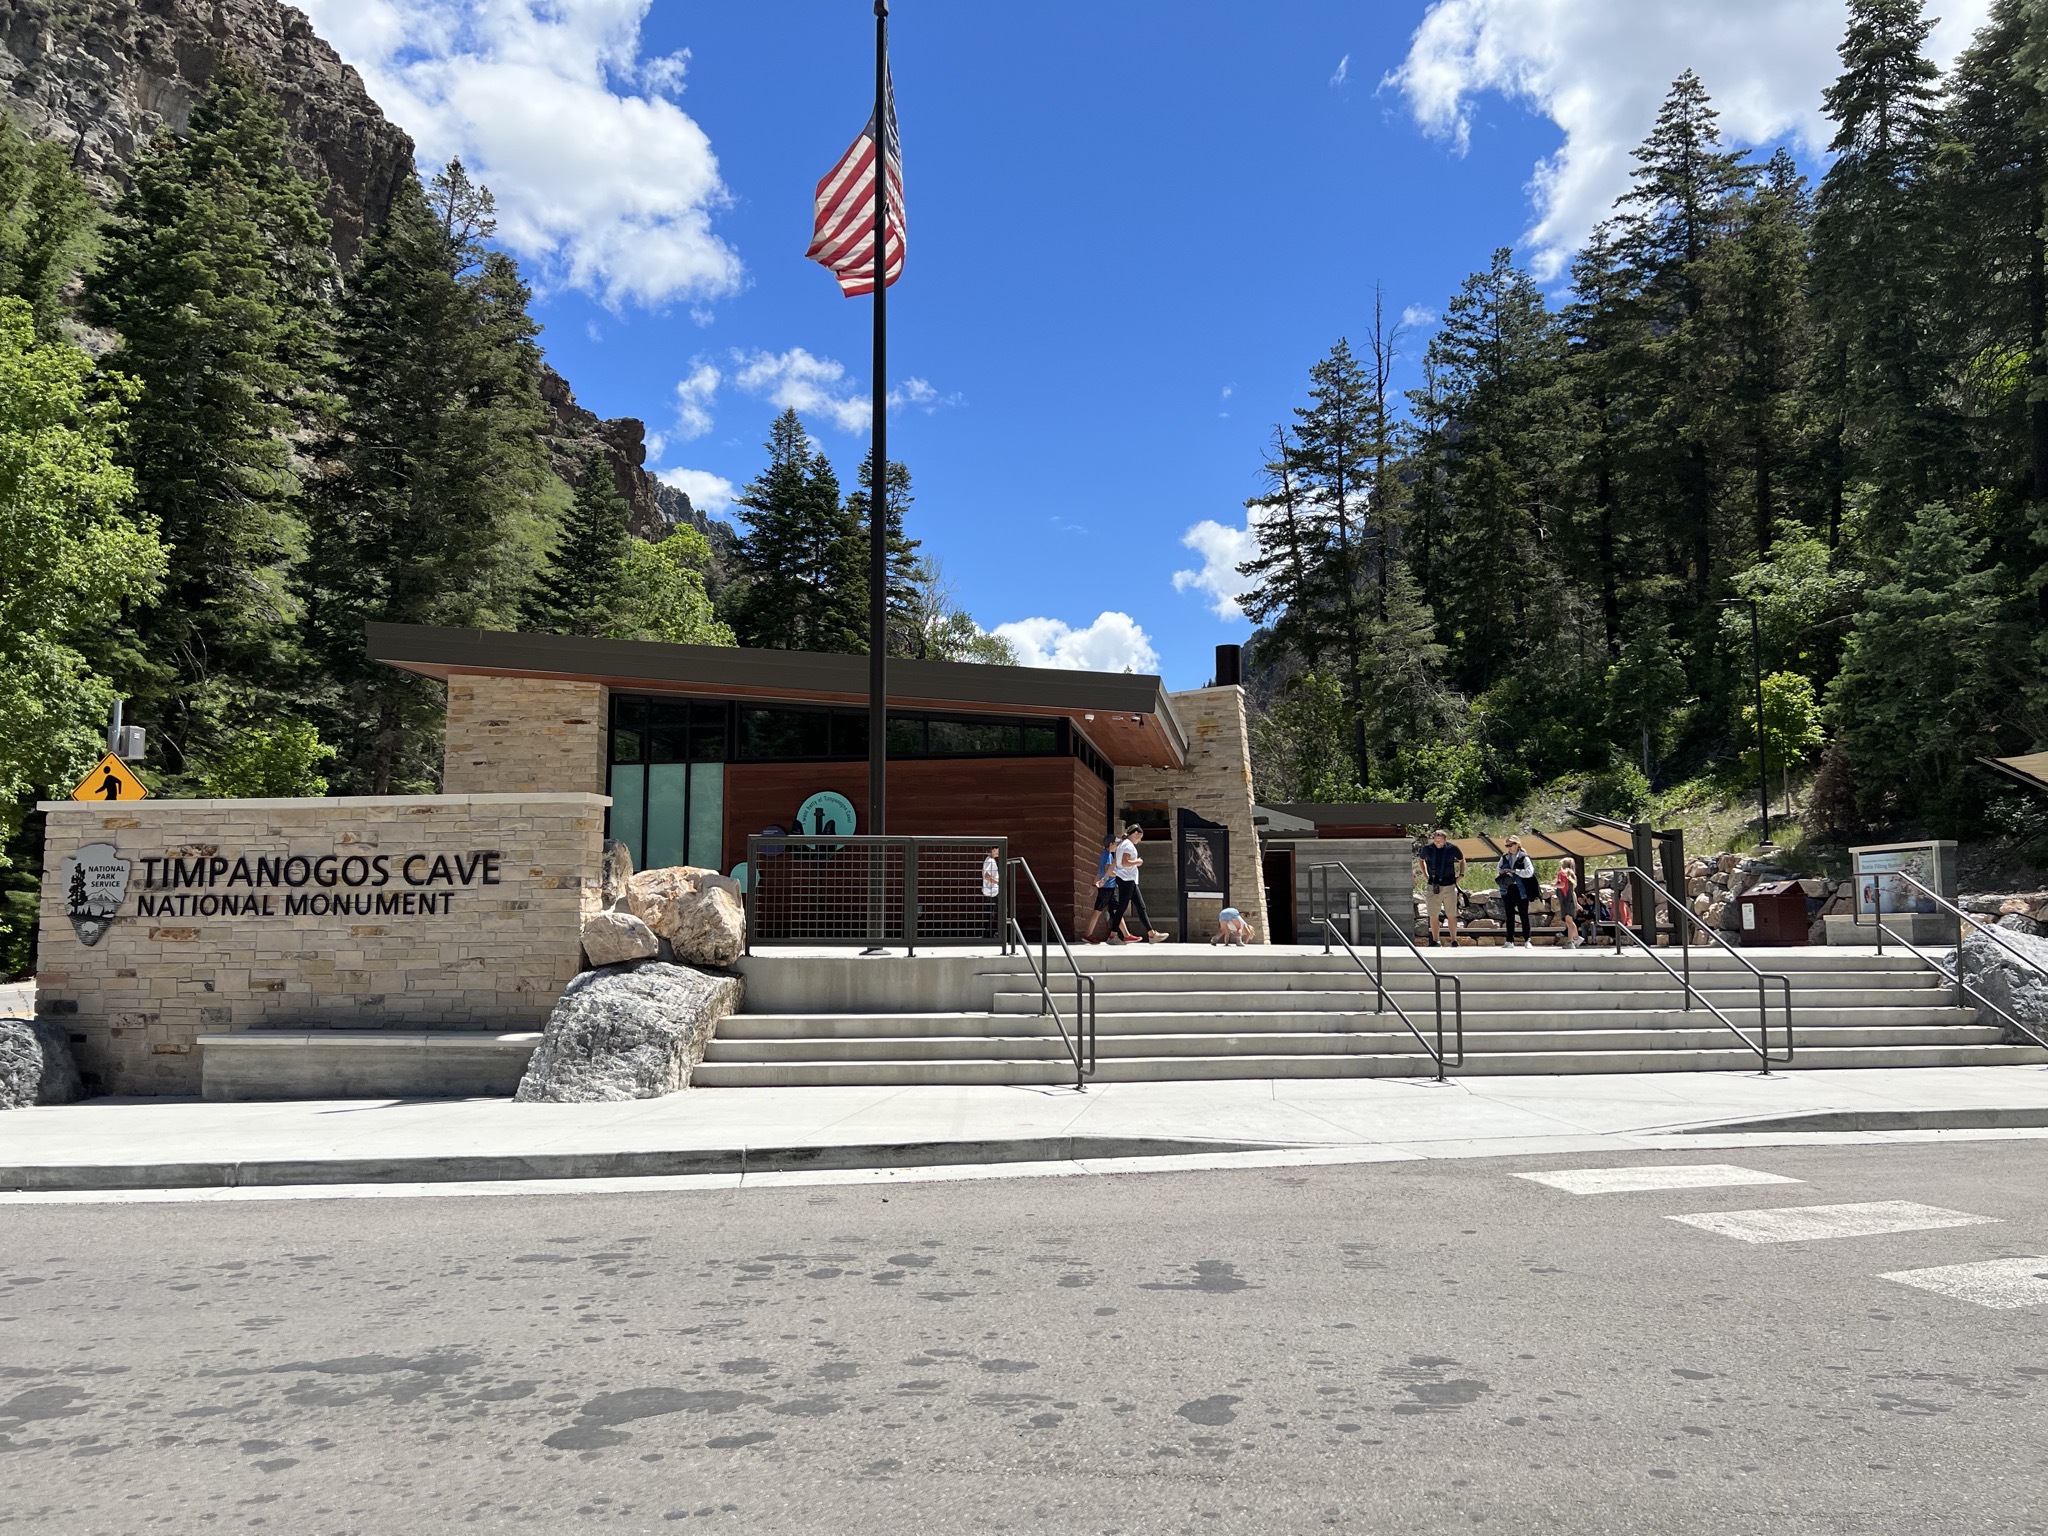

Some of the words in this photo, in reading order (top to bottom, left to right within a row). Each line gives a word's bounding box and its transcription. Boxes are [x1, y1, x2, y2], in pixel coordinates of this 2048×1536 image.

[140, 854, 389, 888] TIMPANOGOS
[402, 853, 500, 886] CAVE
[137, 894, 275, 917] NATIONAL
[285, 892, 455, 916] MONUMENT
